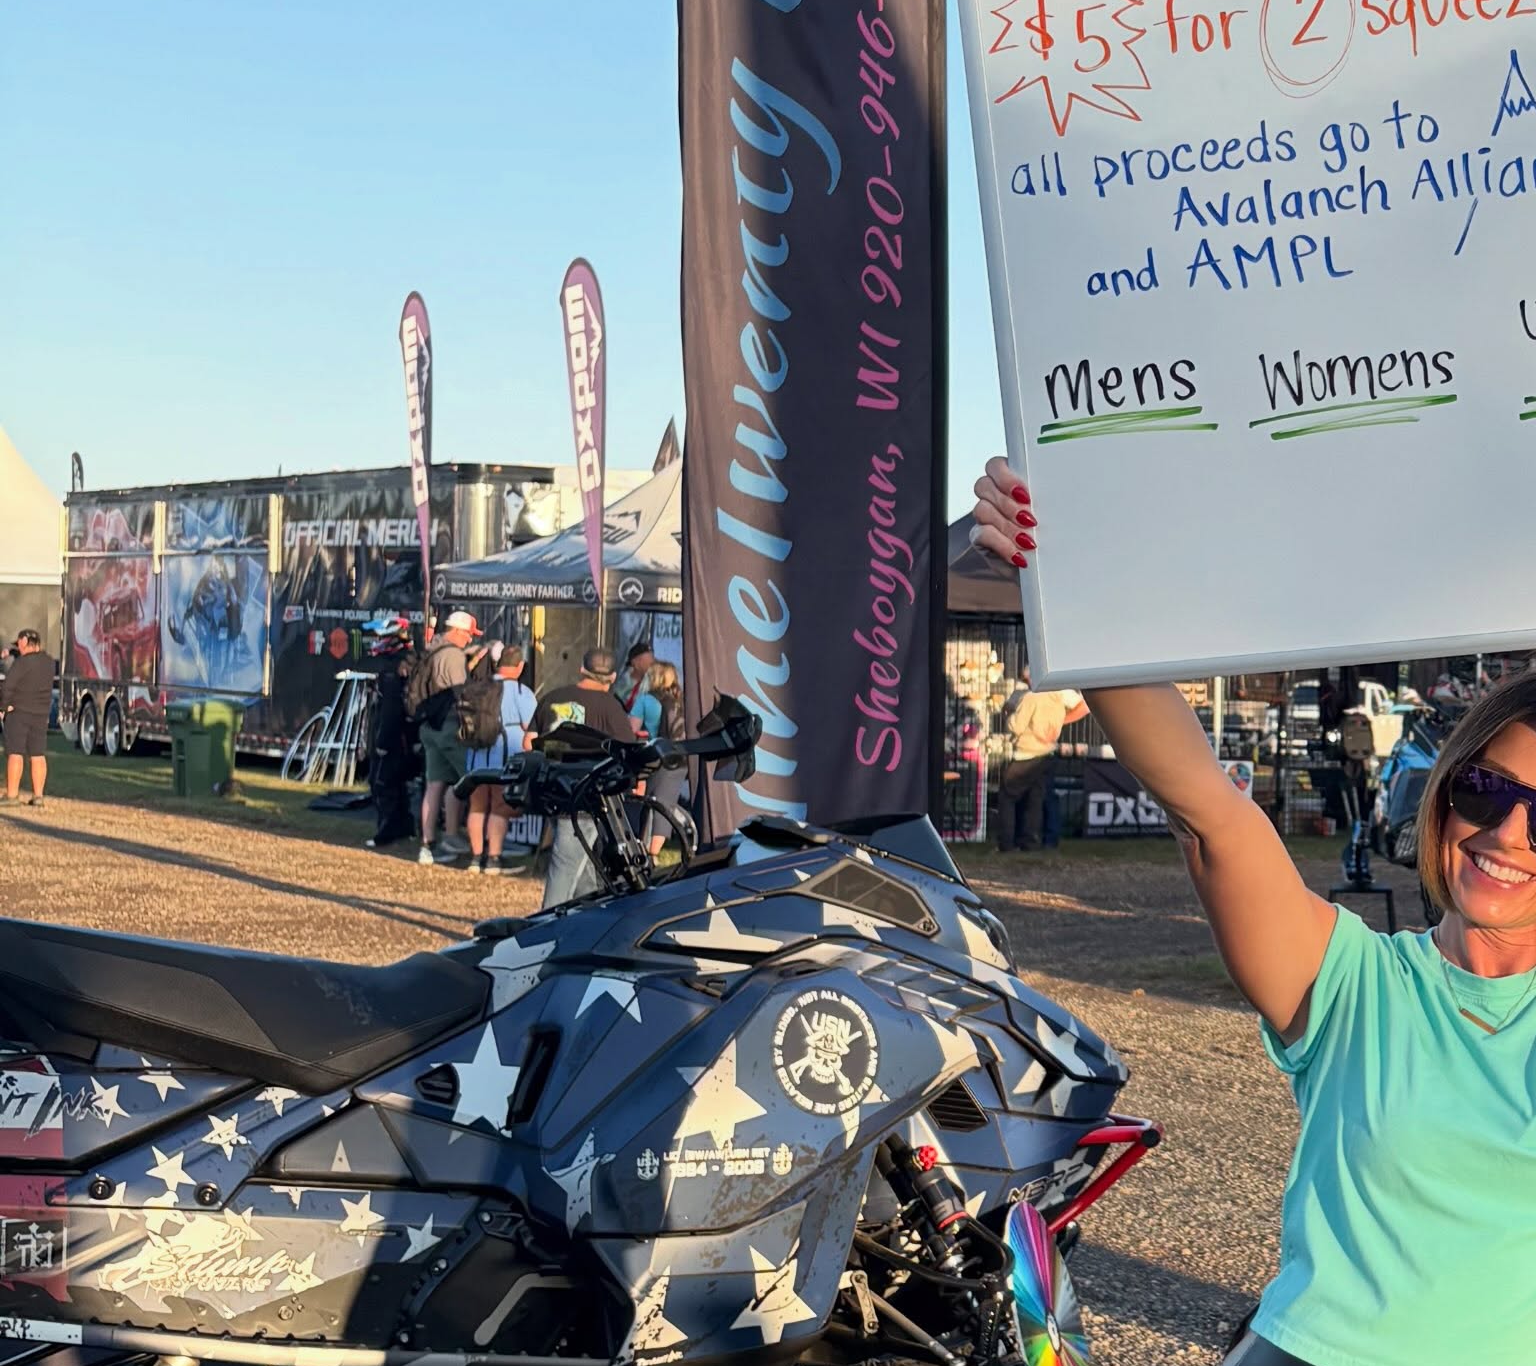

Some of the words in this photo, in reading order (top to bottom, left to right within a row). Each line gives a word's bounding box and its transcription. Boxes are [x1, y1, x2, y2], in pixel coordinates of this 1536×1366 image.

[1010, 148, 1067, 198] all
[1093, 119, 1297, 198] proceeds
[1319, 121, 1370, 174] go
[1383, 99, 1441, 148] to
[1172, 171, 1389, 231] Avalanch
[1085, 248, 1160, 297] and
[1186, 235, 1355, 292] AMPL
[856, 320, 901, 411] WI
[1045, 353, 1199, 419] Mens
[1257, 344, 1457, 410] Womens
[284, 519, 362, 547] OFFICIAL
[657, 587, 682, 603] RID
[853, 443, 915, 772] Sheboygan,
[811, 1010, 852, 1039] USN
[820, 989, 841, 1002] ALL
